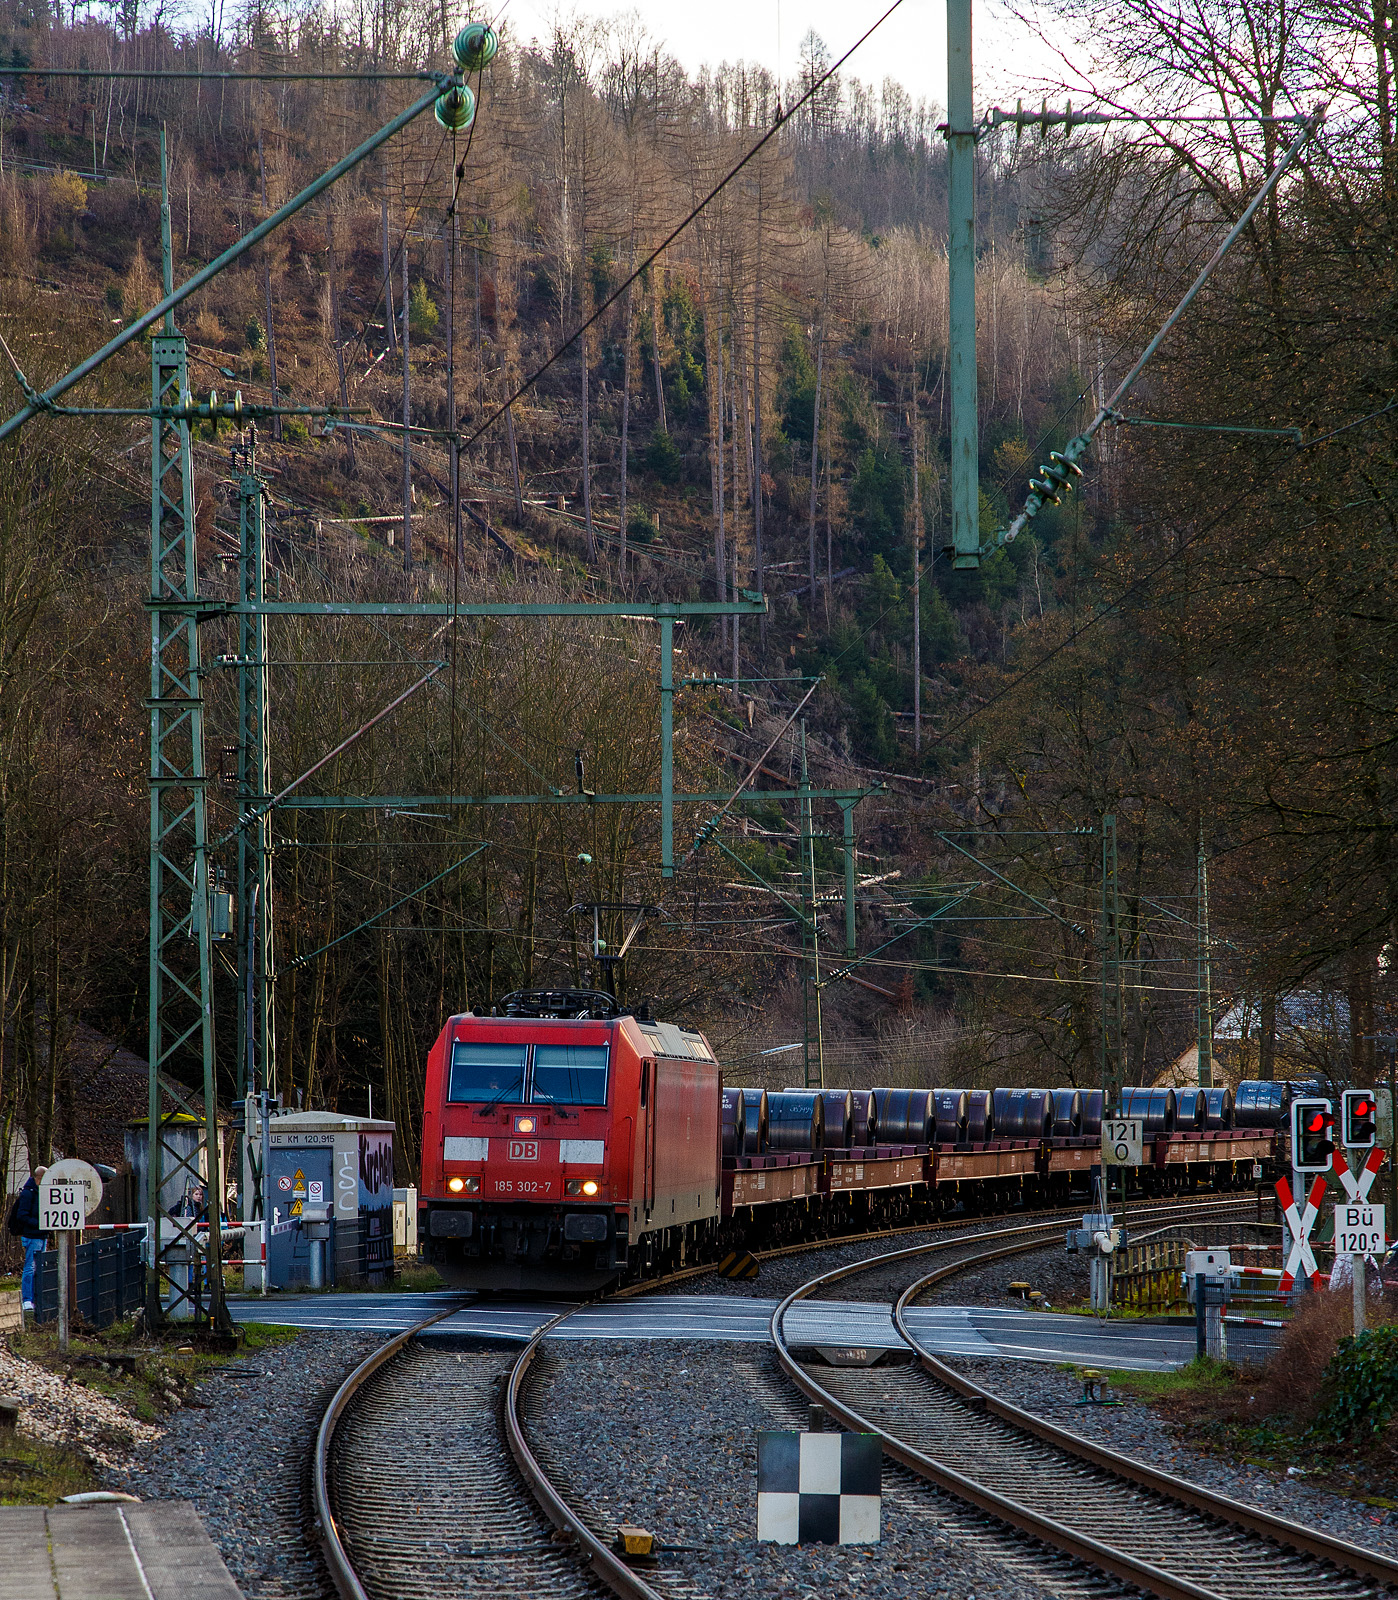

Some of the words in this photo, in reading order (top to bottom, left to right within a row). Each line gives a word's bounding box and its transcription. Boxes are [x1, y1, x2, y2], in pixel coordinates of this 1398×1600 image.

[269, 1135, 282, 1144] UE
[287, 1135, 299, 1144] KM
[304, 1134, 335, 1144] 120,915
[1108, 1122, 1136, 1141] 121
[511, 1142, 537, 1159] DB
[1115, 1143, 1129, 1161] 0
[49, 1187, 74, 1205] Bü
[494, 1181, 513, 1192] 185
[517, 1181, 552, 1193] 302-7
[43, 1210, 80, 1229] 120,9
[1346, 1207, 1374, 1227] Bü
